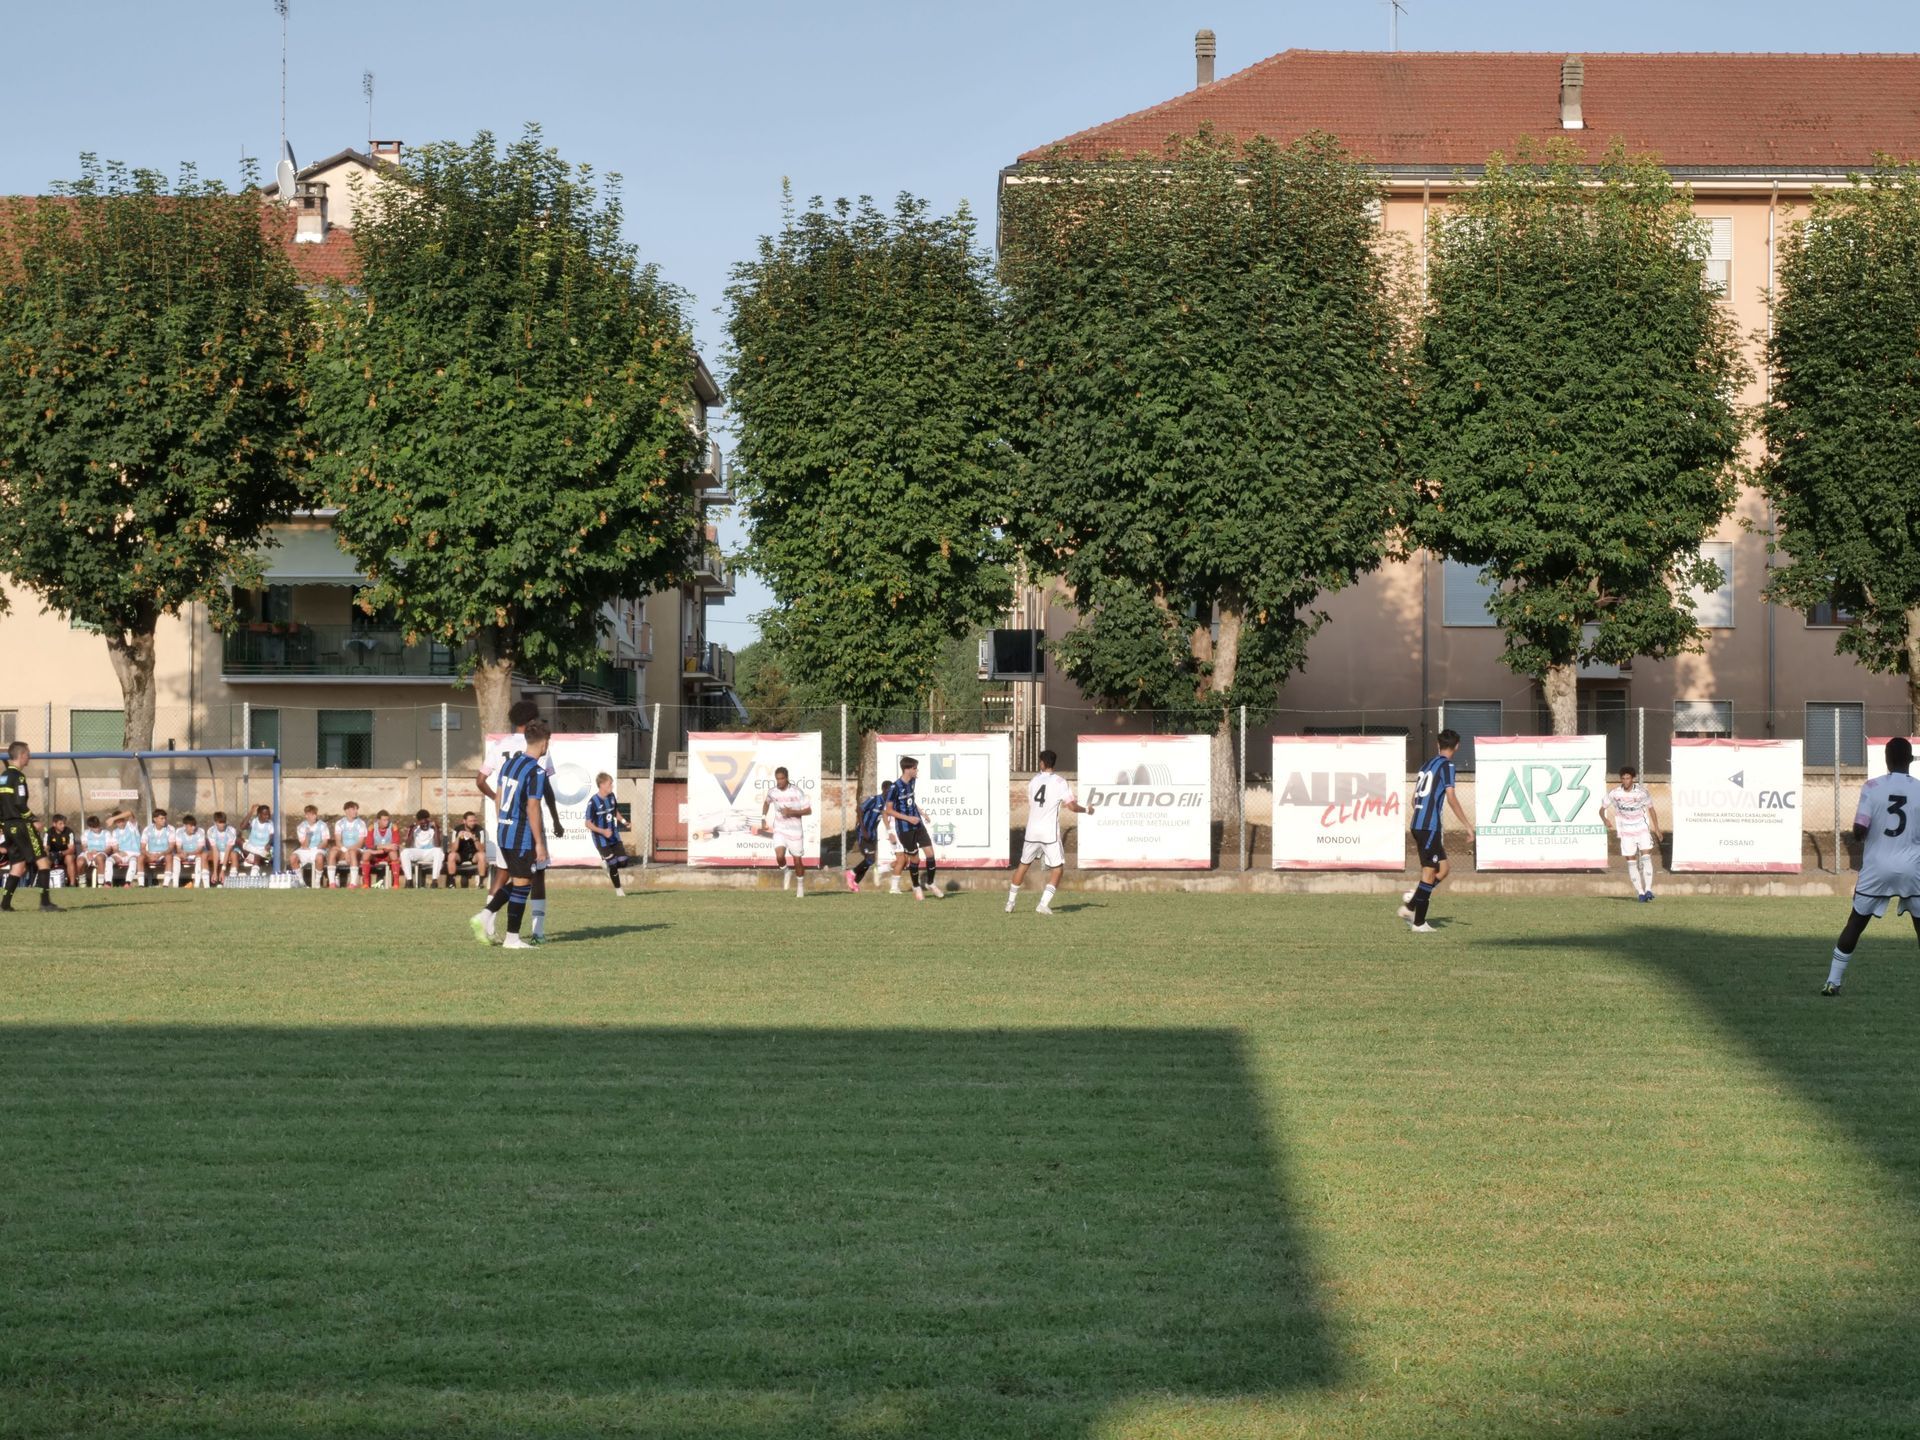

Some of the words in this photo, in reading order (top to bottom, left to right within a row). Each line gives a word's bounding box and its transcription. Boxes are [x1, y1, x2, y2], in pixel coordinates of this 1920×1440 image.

[500, 775, 519, 812] 17
[934, 785, 952, 793] BCC
[1034, 783, 1046, 808] 4
[1279, 772, 1387, 806] ALPI
[1490, 764, 1592, 823] AR3
[921, 797, 957, 805] PIANFEI
[960, 797, 965, 805] E
[1086, 787, 1175, 807] bruno
[955, 808, 983, 816] BALDI
[1120, 811, 1168, 819] COSTRUZIONI
[1320, 792, 1400, 828] CLIMA
[1883, 794, 1908, 838] 3
[1146, 819, 1190, 827] METALLICHE
[1479, 827, 1526, 835] ELEMENTI
[1530, 826, 1605, 835] PREFABBRICATI
[1504, 837, 1524, 845] PER
[1529, 836, 1579, 845] L'EDILIZIA
